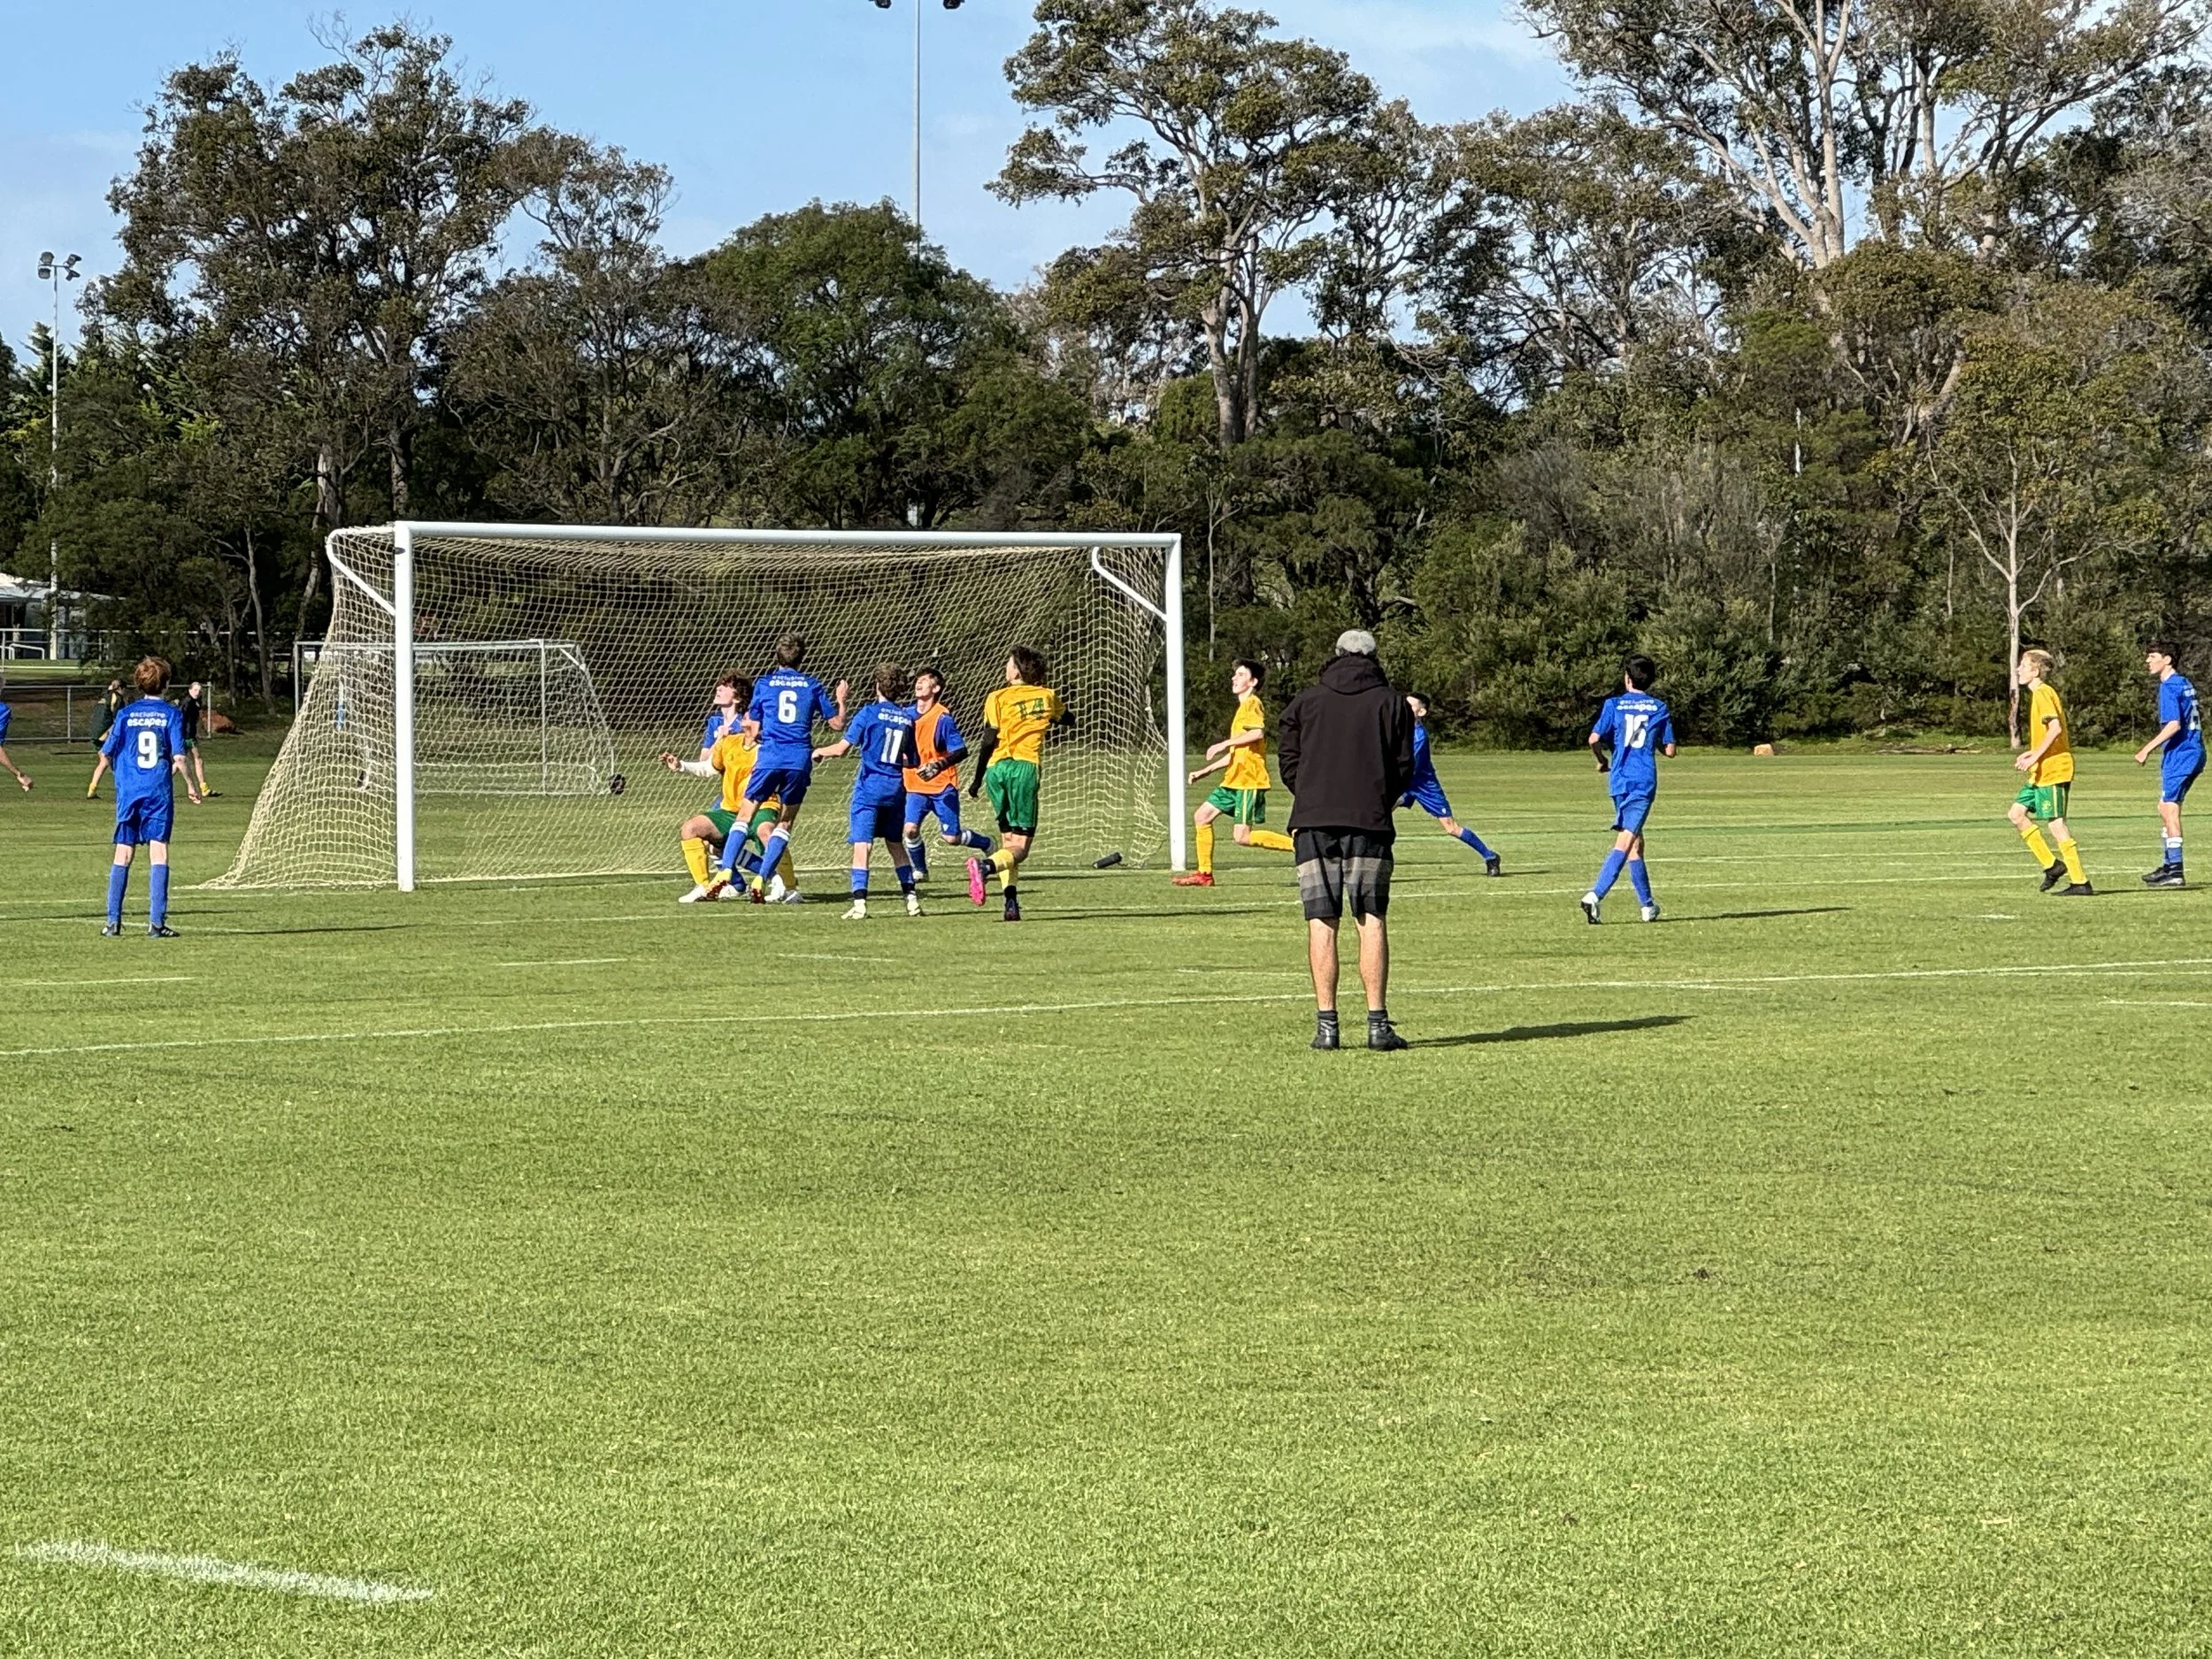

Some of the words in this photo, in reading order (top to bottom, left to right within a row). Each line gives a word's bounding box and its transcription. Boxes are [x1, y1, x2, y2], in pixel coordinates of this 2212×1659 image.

[127, 718, 167, 727] escapes
[779, 690, 797, 724] 6
[880, 727, 903, 764] 11
[1624, 713, 1649, 749] 16
[137, 731, 157, 769] 9
